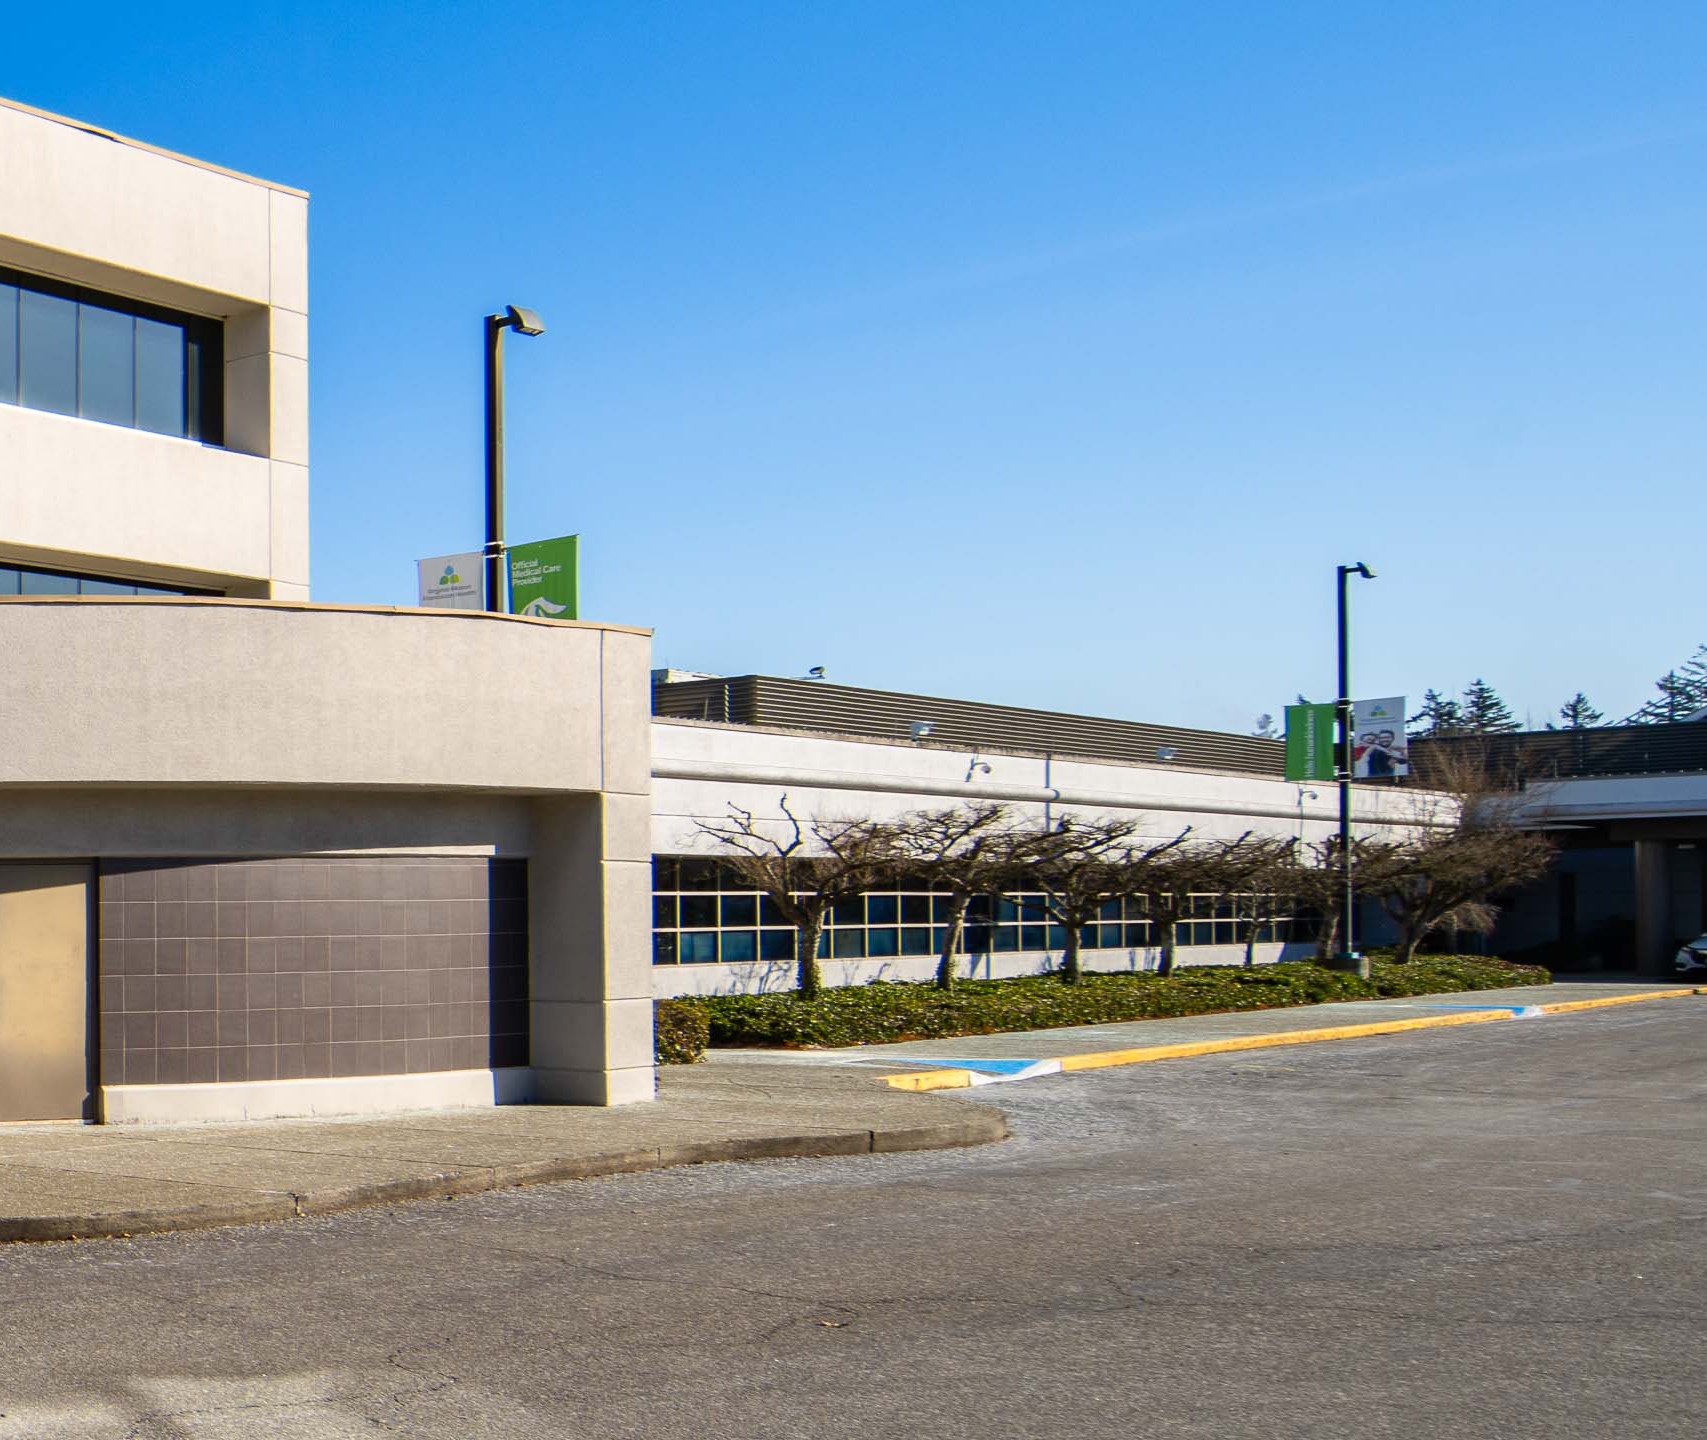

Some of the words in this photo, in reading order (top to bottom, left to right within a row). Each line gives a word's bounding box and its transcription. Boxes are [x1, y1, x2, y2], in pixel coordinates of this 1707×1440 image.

[512, 559, 538, 570] Official
[512, 568, 541, 579] Medical
[543, 565, 562, 574] Care
[512, 577, 542, 587] Provider
